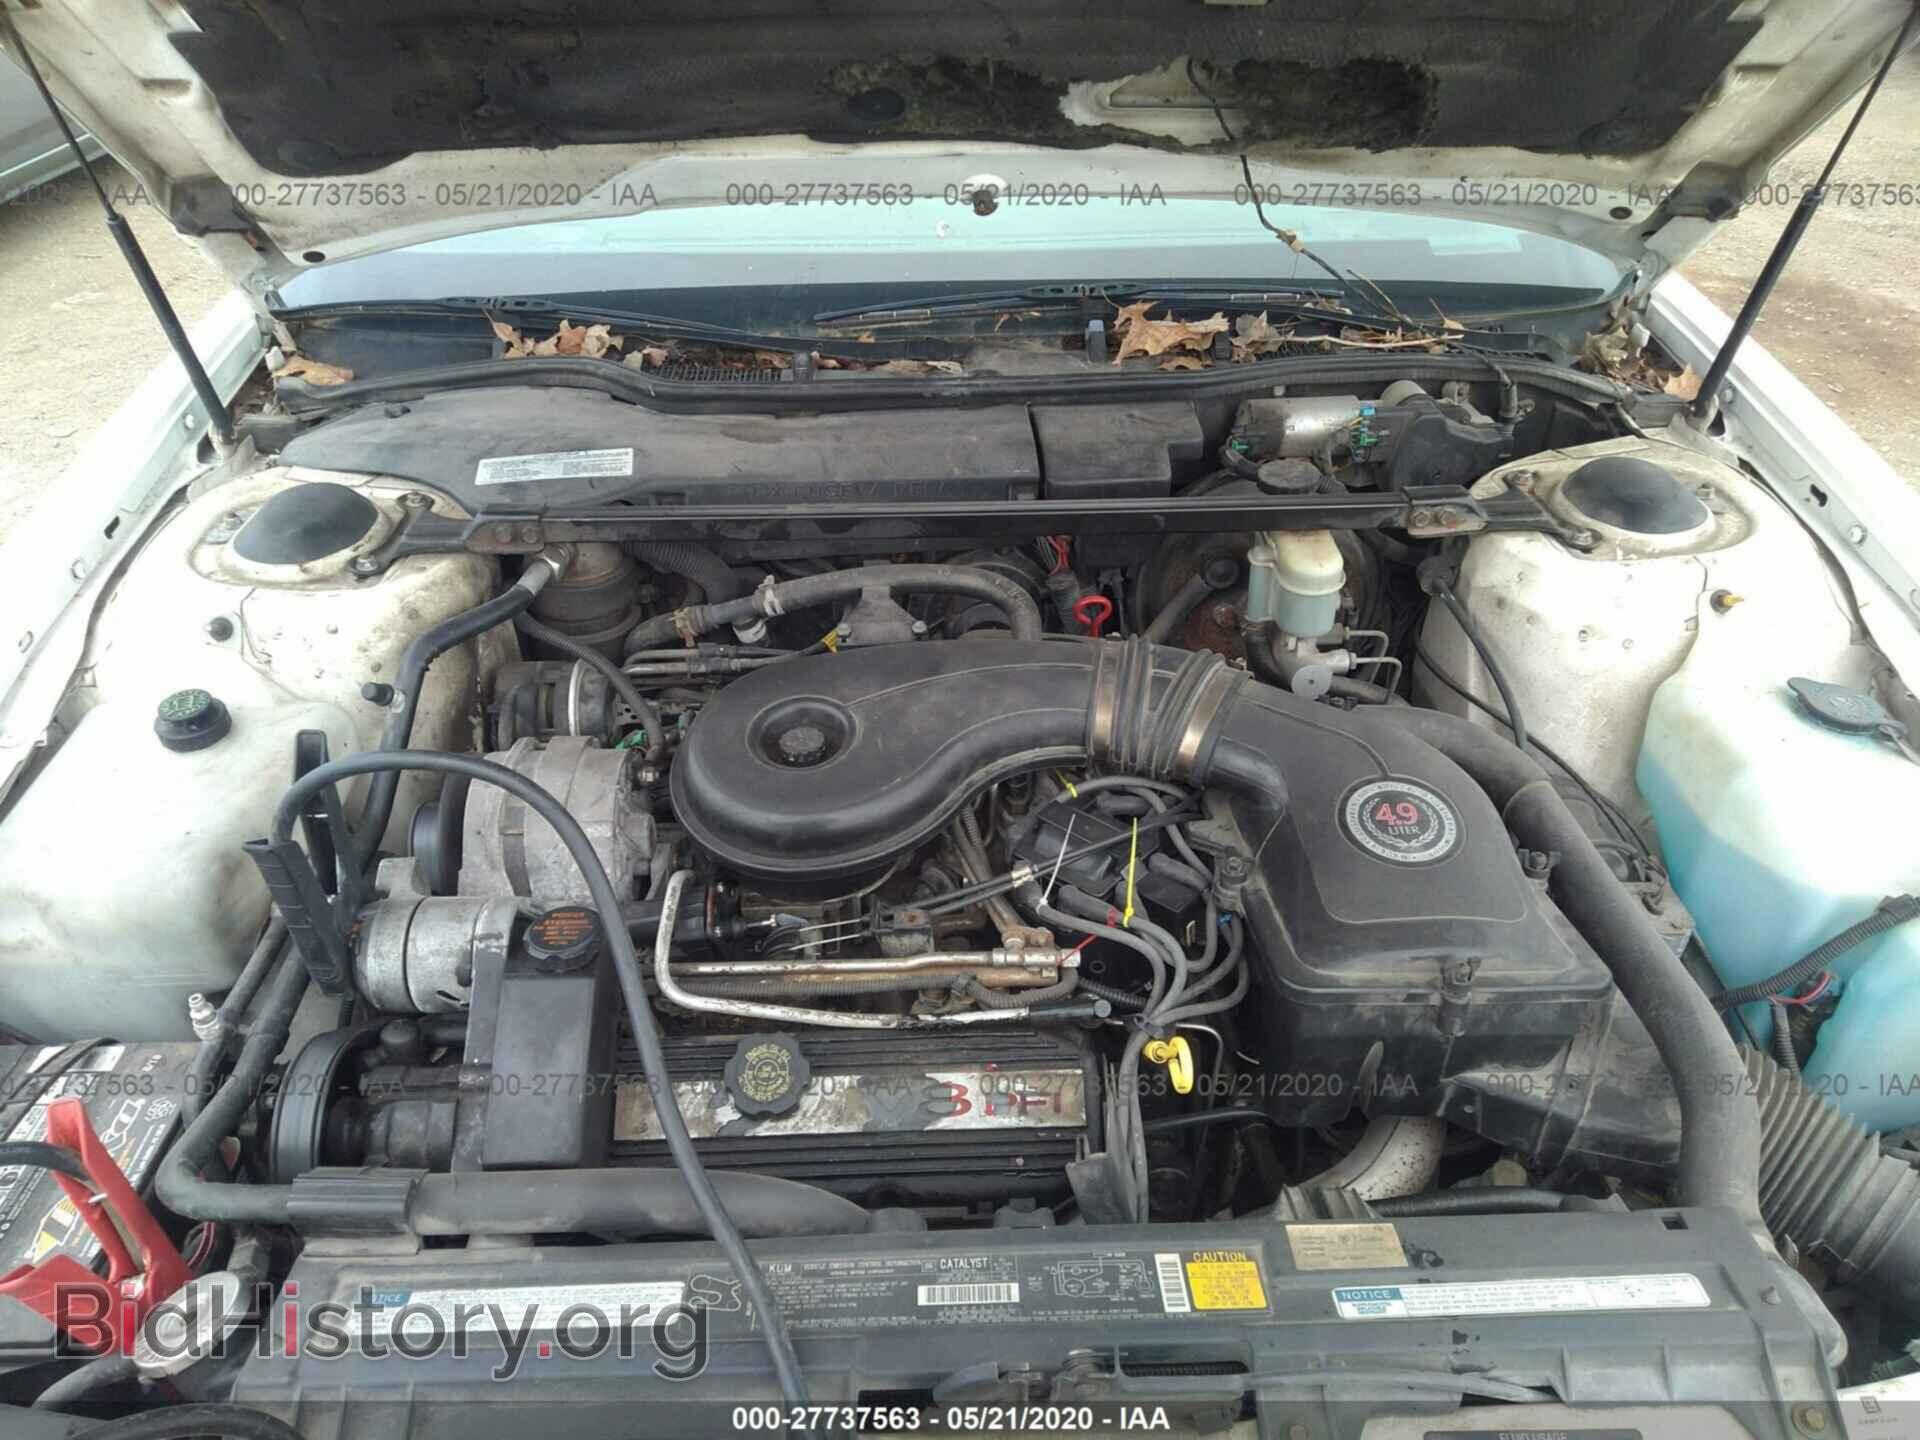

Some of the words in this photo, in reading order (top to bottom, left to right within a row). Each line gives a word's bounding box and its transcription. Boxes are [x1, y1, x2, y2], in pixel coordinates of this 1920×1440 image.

[1193, 1251, 1248, 1263] CAUTION
[939, 1257, 988, 1270] CATALYST
[1341, 1289, 1392, 1300] NOTICE
